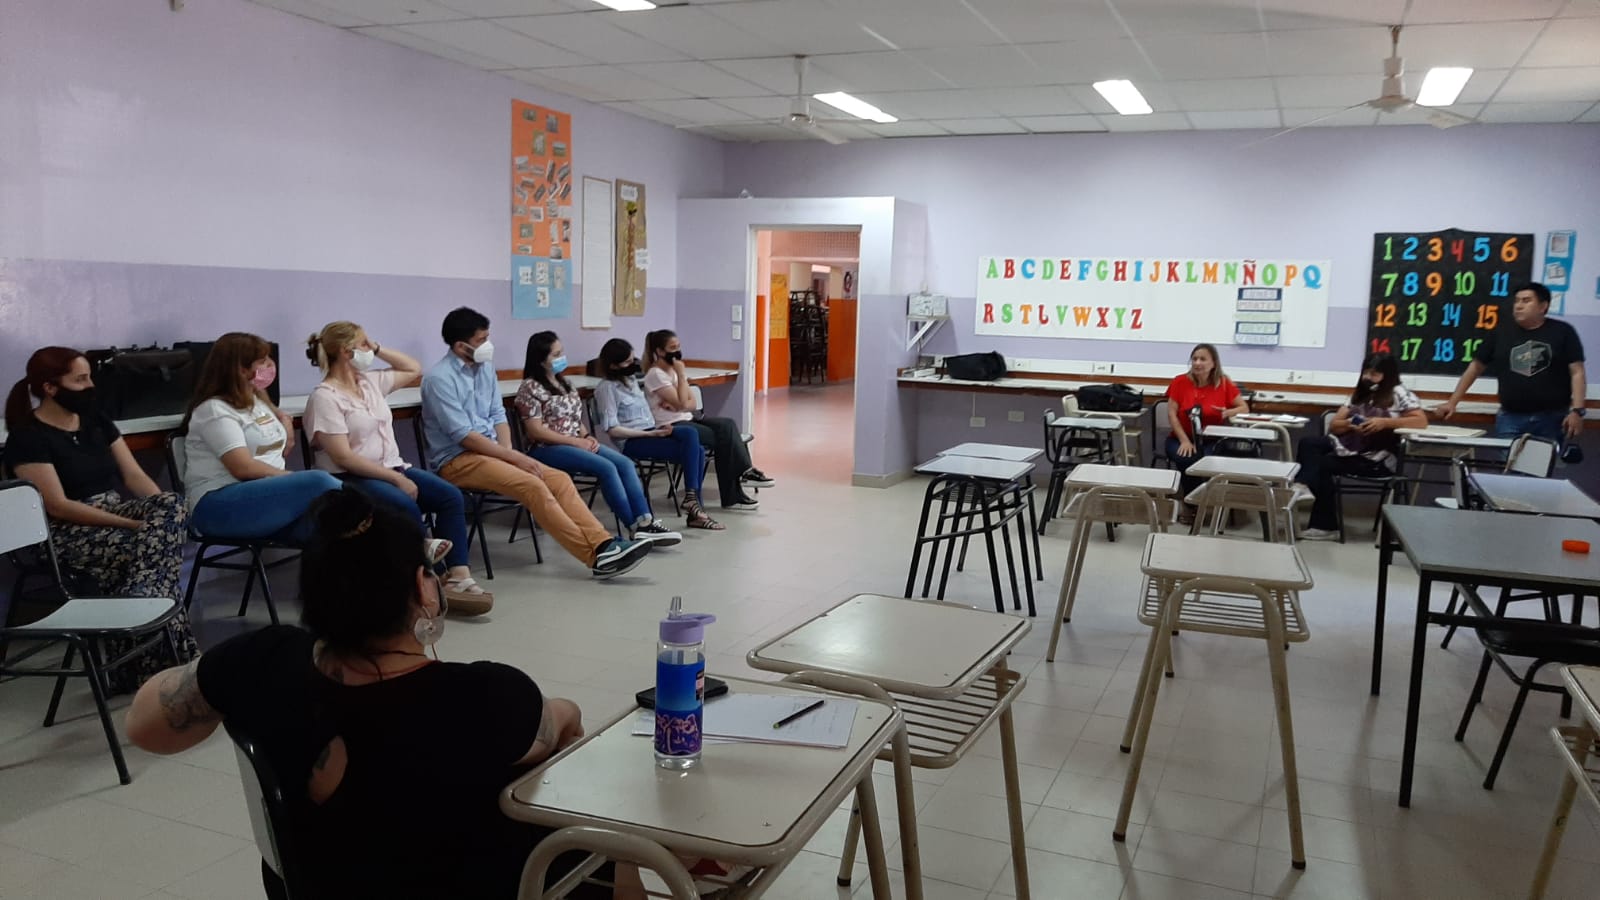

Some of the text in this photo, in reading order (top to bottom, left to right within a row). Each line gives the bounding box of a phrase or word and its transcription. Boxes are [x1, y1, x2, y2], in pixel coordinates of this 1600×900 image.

[1383, 236, 1518, 262] 1 2 3 4 5 6
[987, 258, 1322, 289] A B C D E F G H I J K L M N Ñ O P Q
[1381, 271, 1509, 297] 7 8 9 10 11
[983, 303, 994, 323] R
[1002, 303, 1013, 324] S
[1019, 303, 1032, 324] T
[1056, 305, 1068, 325] V
[1073, 305, 1092, 327] W
[1097, 306, 1109, 328] X
[1115, 307, 1126, 328] Y
[1131, 308, 1142, 329] Z
[1375, 303, 1498, 329] 12 13 14 15
[1371, 338, 1390, 353] 16
[1401, 338, 1422, 361] 17
[1433, 337, 1454, 362] 18
